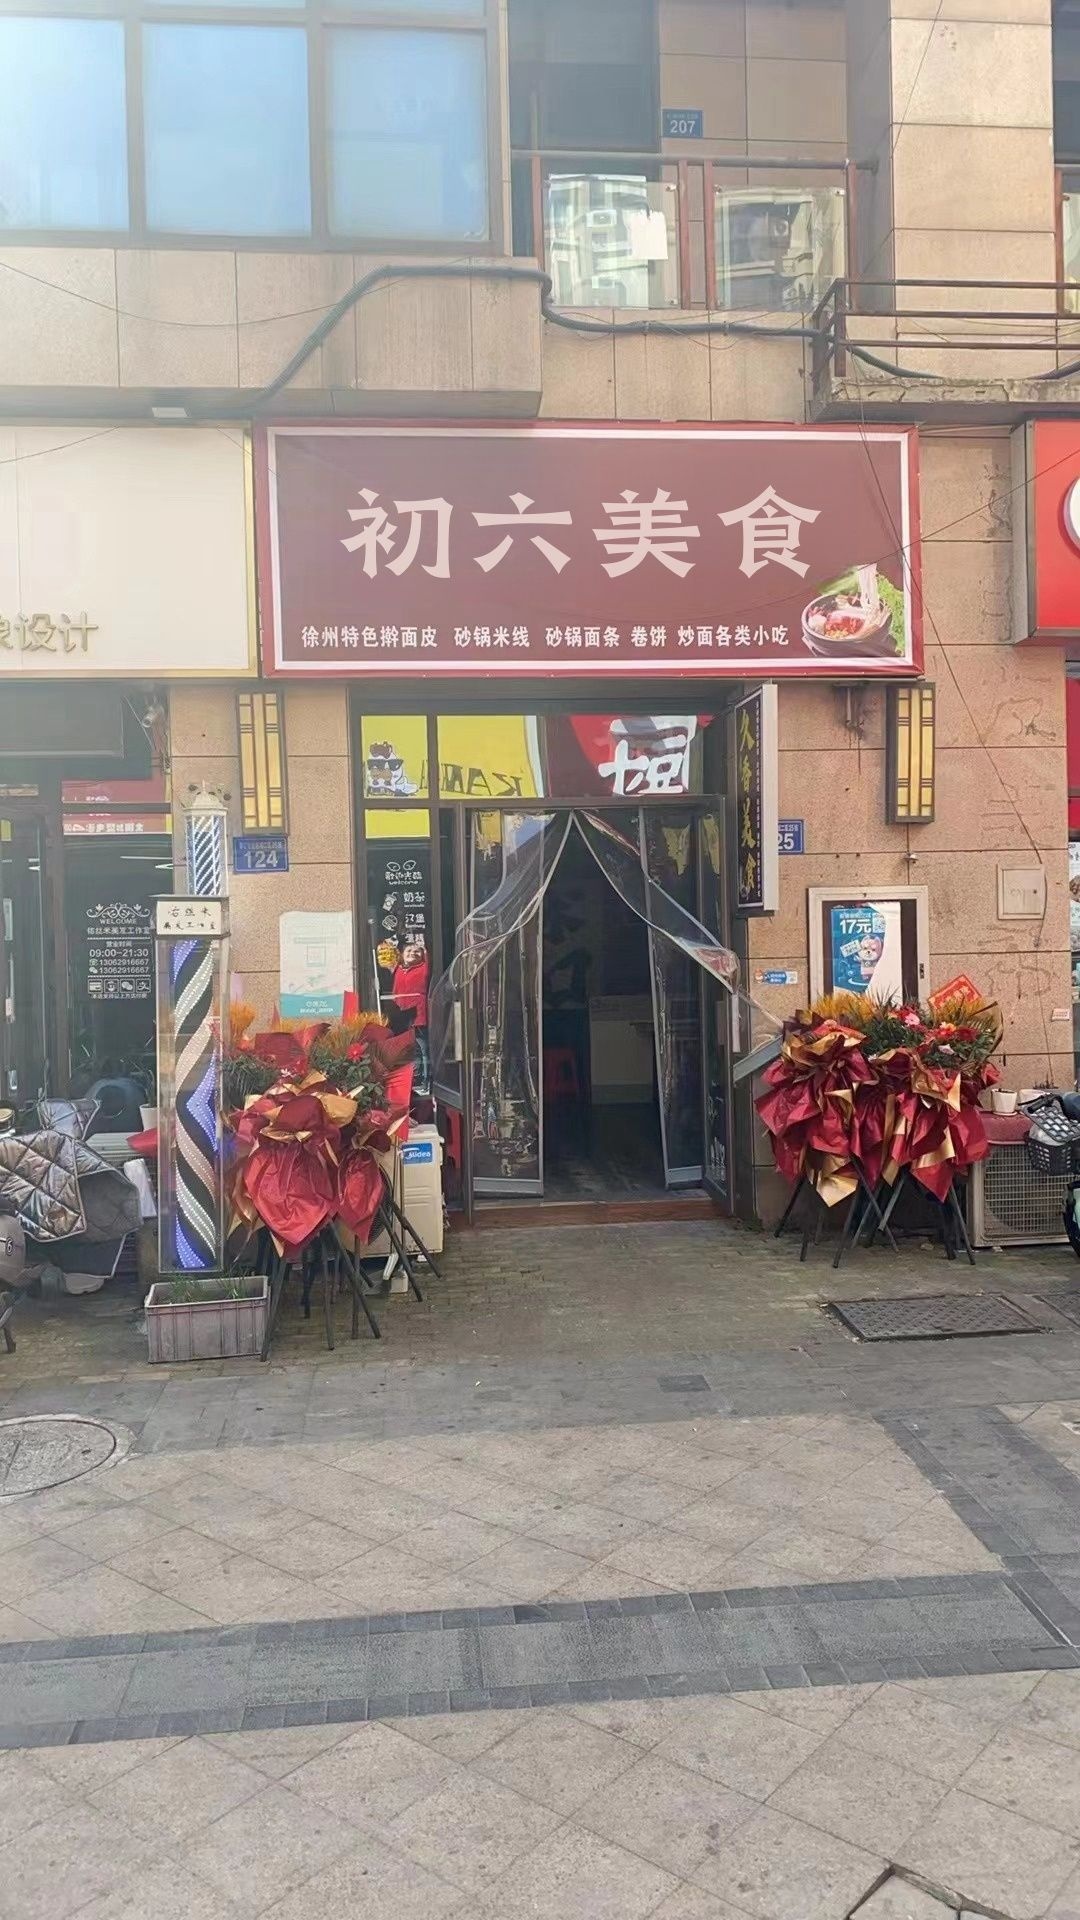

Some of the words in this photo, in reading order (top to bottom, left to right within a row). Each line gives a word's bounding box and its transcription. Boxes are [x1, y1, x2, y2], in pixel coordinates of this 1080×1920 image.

[670, 119, 696, 134] 207
[340, 485, 822, 579] 初六美食
[301, 625, 438, 648] 徐州特色擀面皮
[454, 625, 530, 648] 砂锅米线
[545, 625, 621, 648] 砂锅面条
[631, 625, 667, 647] 卷饼
[677, 624, 789, 647] 炒面各类小吃
[244, 850, 278, 869] 124
[840, 918, 872, 934] 17元
[89, 948, 150, 958] 09:00-21:30
